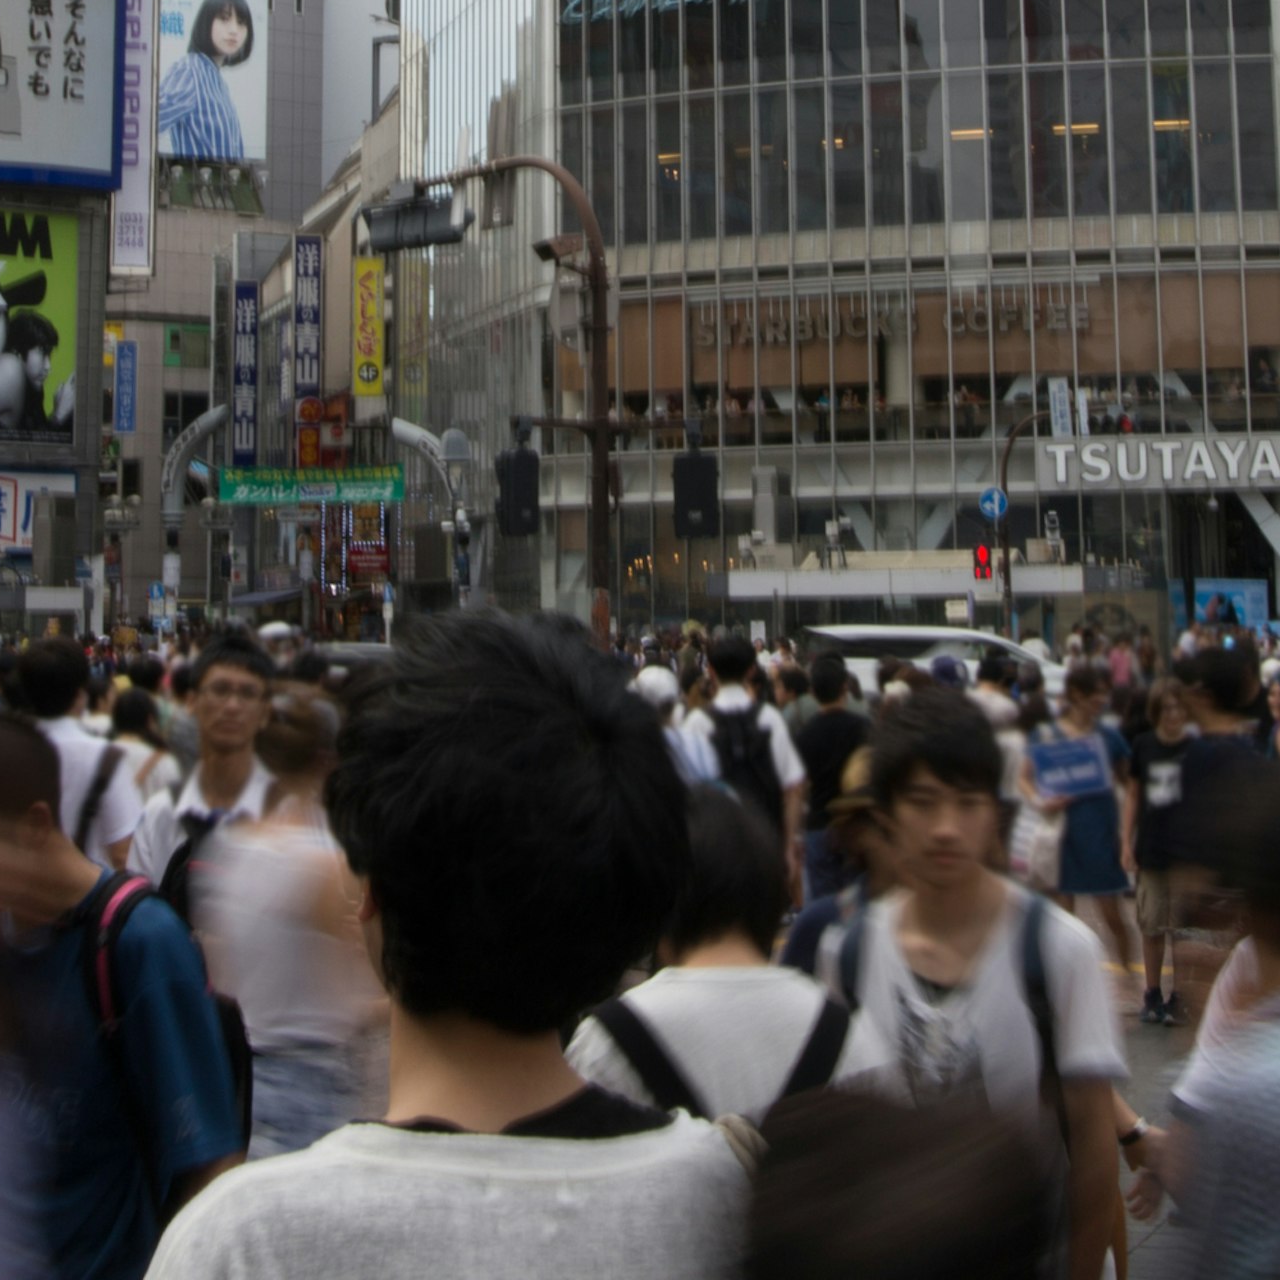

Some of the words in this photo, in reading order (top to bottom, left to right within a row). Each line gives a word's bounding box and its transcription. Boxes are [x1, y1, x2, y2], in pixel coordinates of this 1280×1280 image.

[122, 65, 142, 167] neon
[296, 242, 321, 385] 洋服の青山
[696, 307, 918, 345] STARBUCKS
[942, 302, 1090, 333] COFFEE
[234, 299, 257, 451] 洋服の青山
